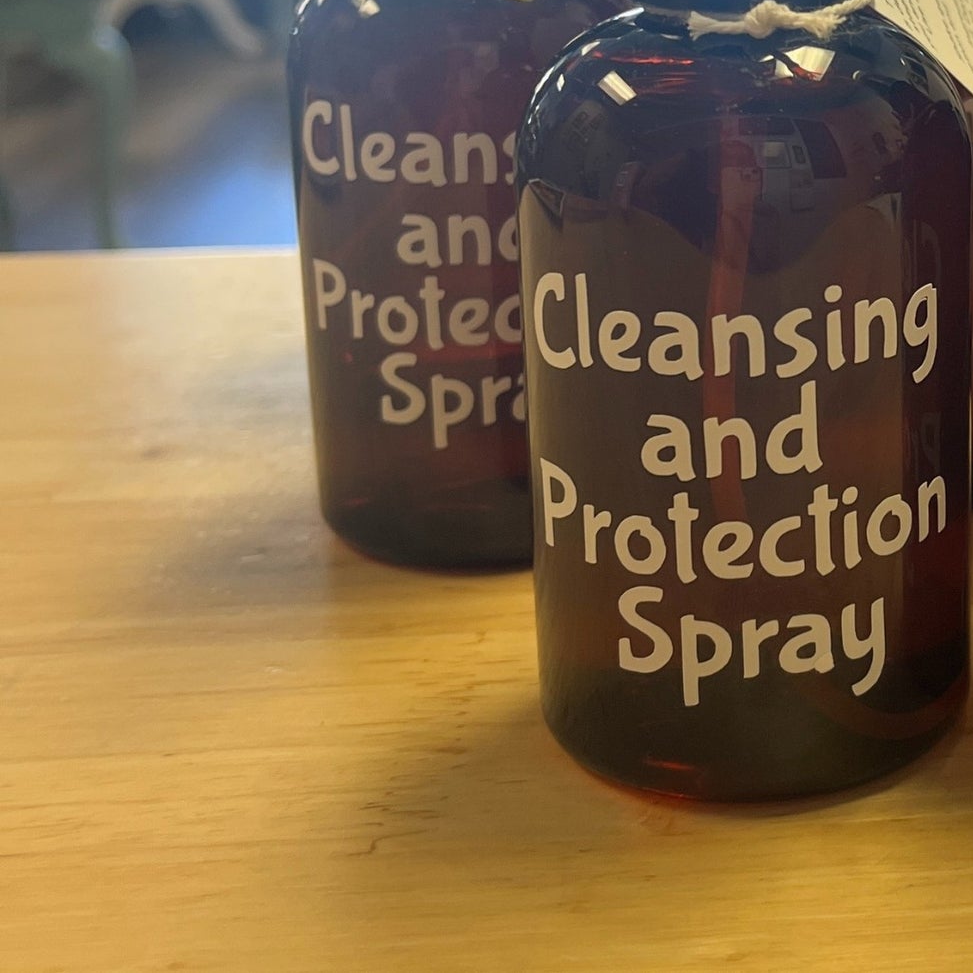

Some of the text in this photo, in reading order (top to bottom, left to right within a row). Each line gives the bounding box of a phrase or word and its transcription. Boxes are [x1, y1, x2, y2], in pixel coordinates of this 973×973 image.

[533, 271, 939, 384] Cleansing
[640, 379, 823, 482] and
[539, 457, 947, 584] Protection
[617, 584, 886, 707] Spray
